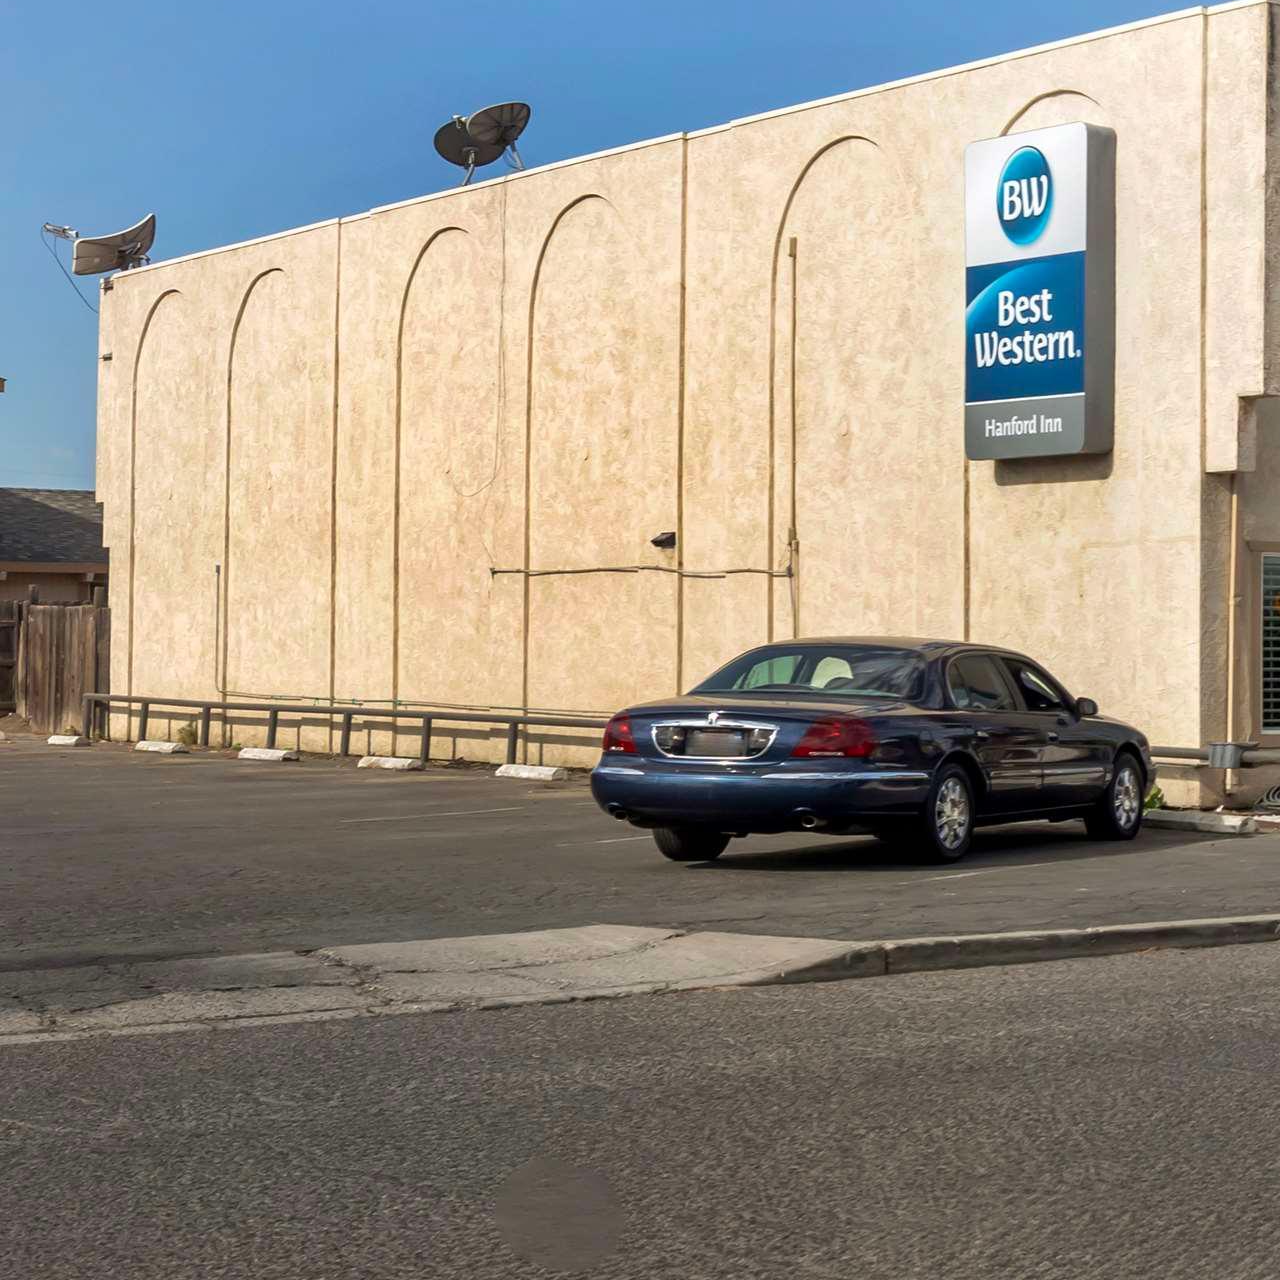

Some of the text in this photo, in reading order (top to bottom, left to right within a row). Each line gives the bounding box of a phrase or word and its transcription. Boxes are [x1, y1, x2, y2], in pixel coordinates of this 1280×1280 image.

[1003, 175, 1048, 221] BW
[998, 288, 1053, 327] Best
[985, 413, 1063, 438] Hanford Inn
